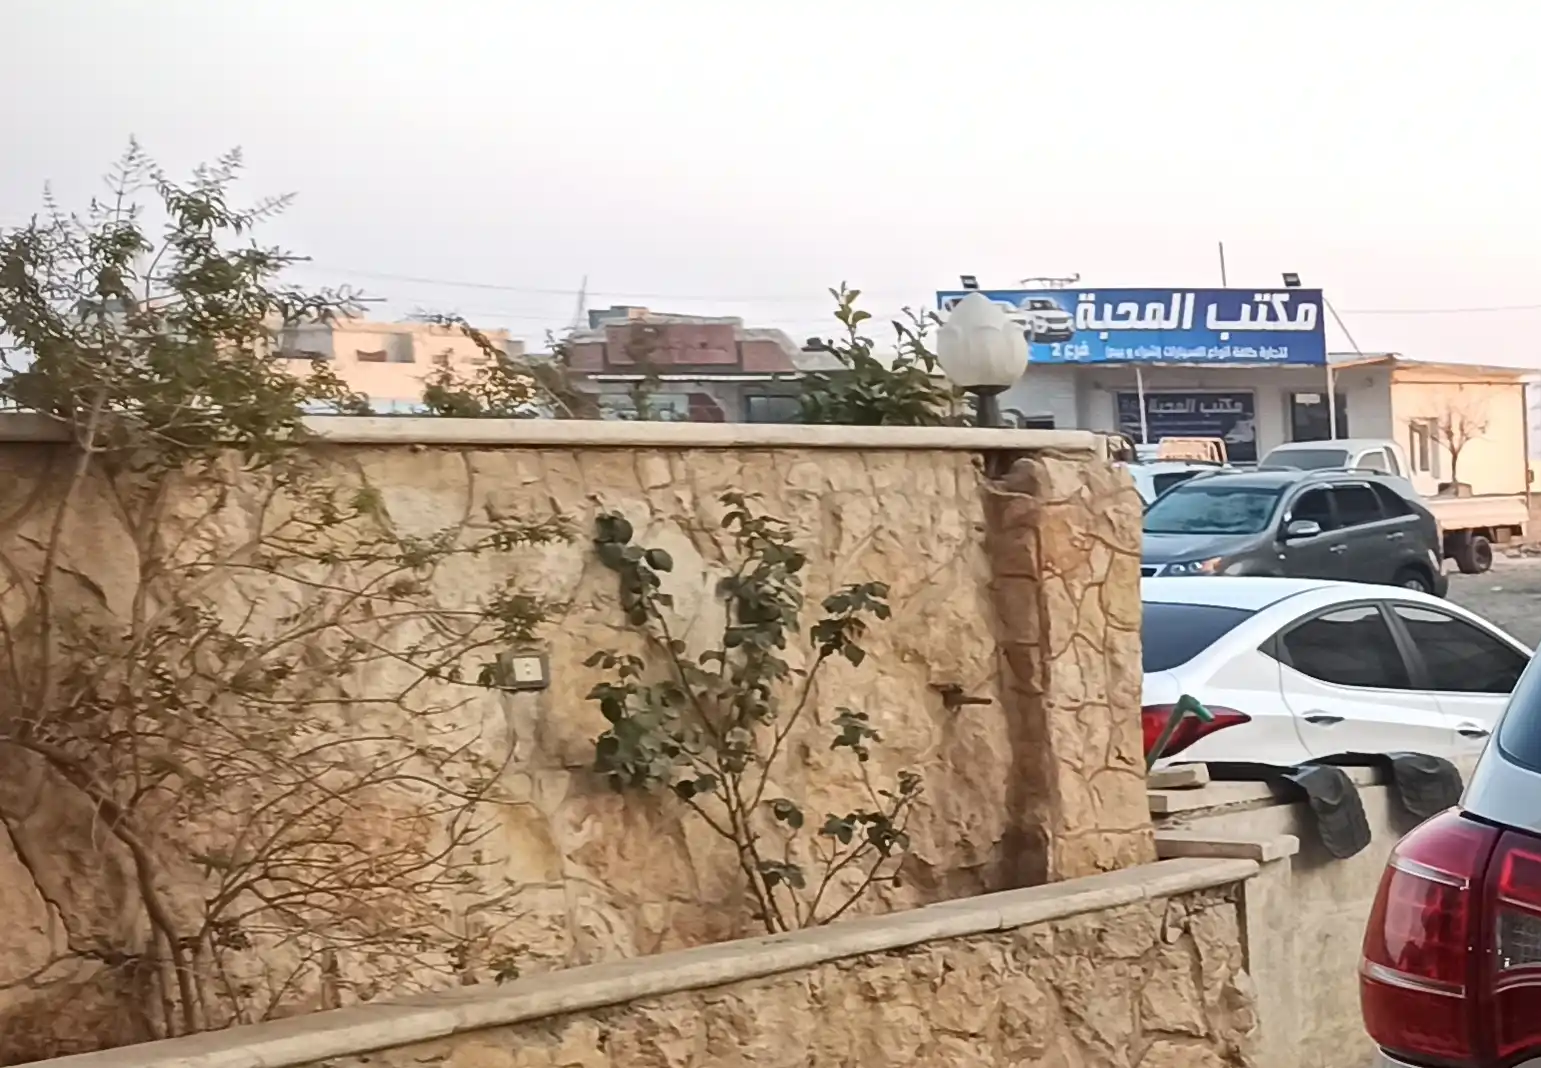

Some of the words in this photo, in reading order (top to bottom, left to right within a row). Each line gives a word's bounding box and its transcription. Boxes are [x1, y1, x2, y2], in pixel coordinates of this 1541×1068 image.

[1076, 292, 1195, 340] المحبة
[1206, 293, 1318, 340] مكتب
[1200, 398, 1244, 417] مكتب
